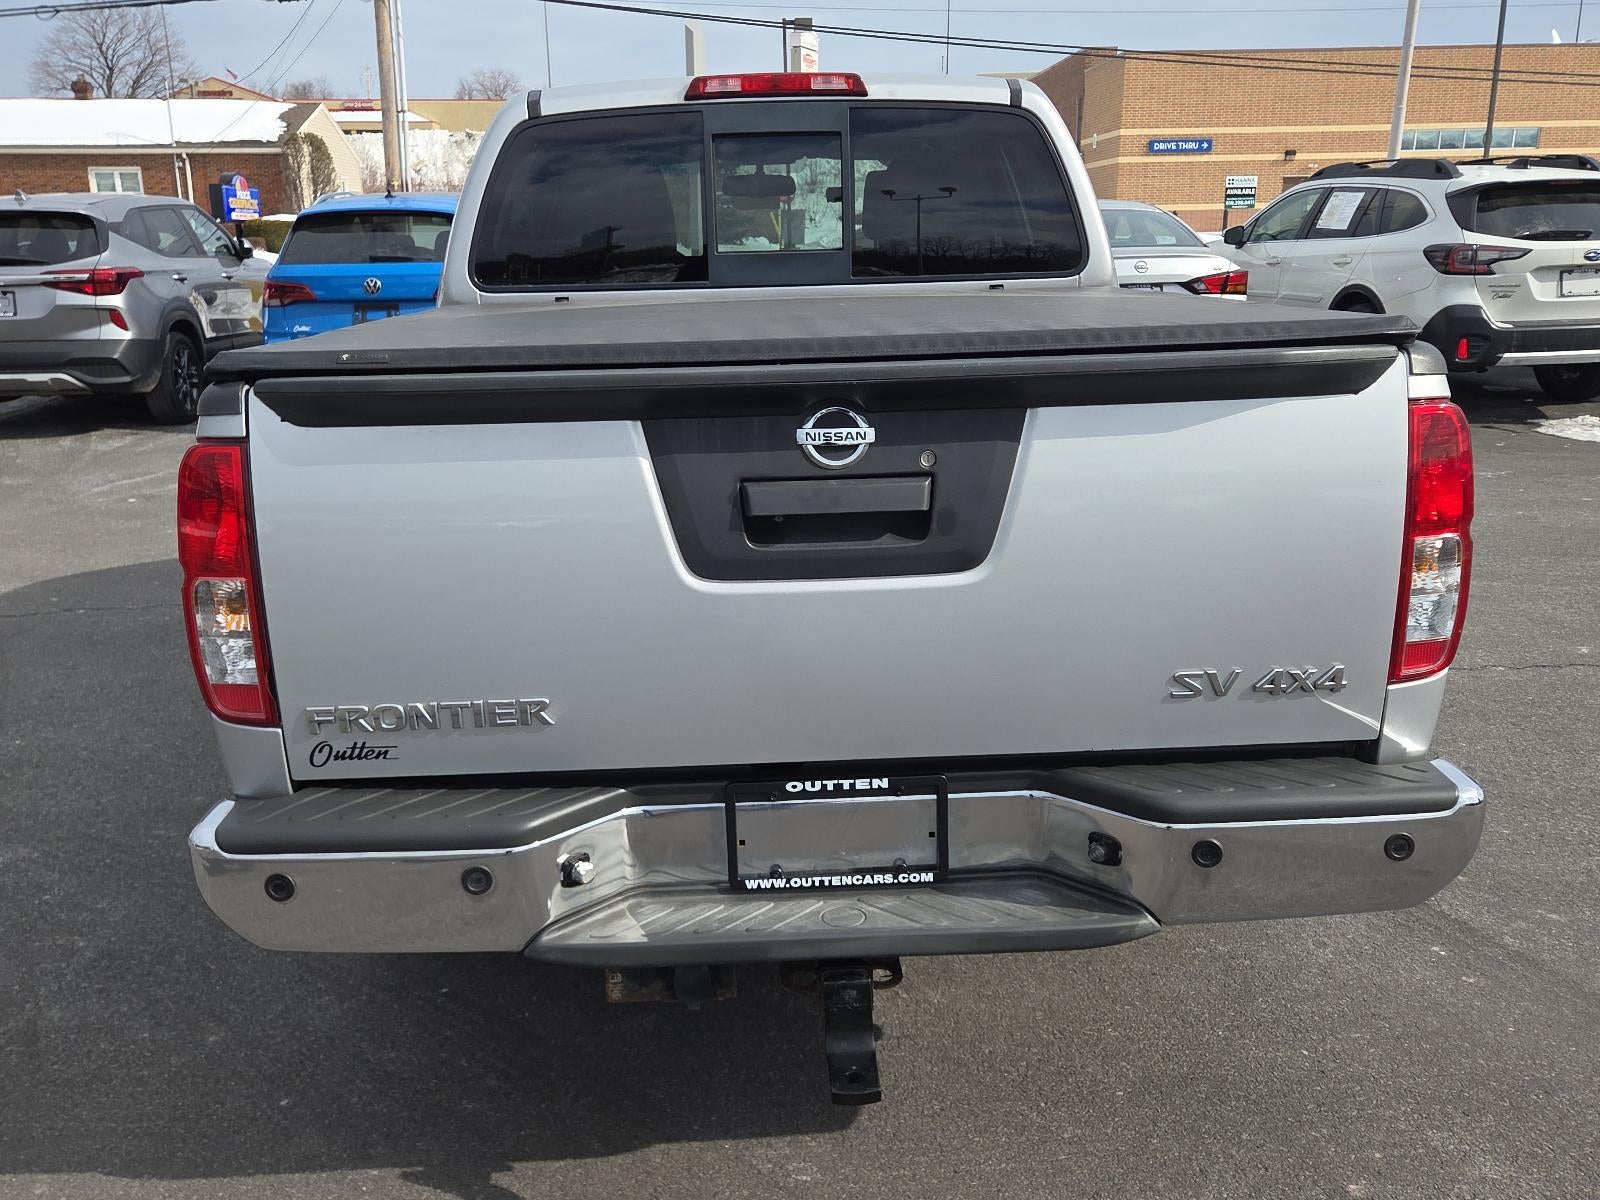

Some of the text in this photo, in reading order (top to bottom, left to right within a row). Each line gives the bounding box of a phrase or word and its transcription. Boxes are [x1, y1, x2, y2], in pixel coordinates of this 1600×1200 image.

[1153, 141, 1199, 150] DRIVE THRU
[805, 431, 867, 442] NISSAN
[1170, 669, 1243, 698] SV
[305, 697, 556, 735] FRONTIER
[309, 740, 400, 768] Outten
[785, 778, 889, 792] OUTTEN
[744, 872, 934, 890] WWW.OUTTENCARS.COM
